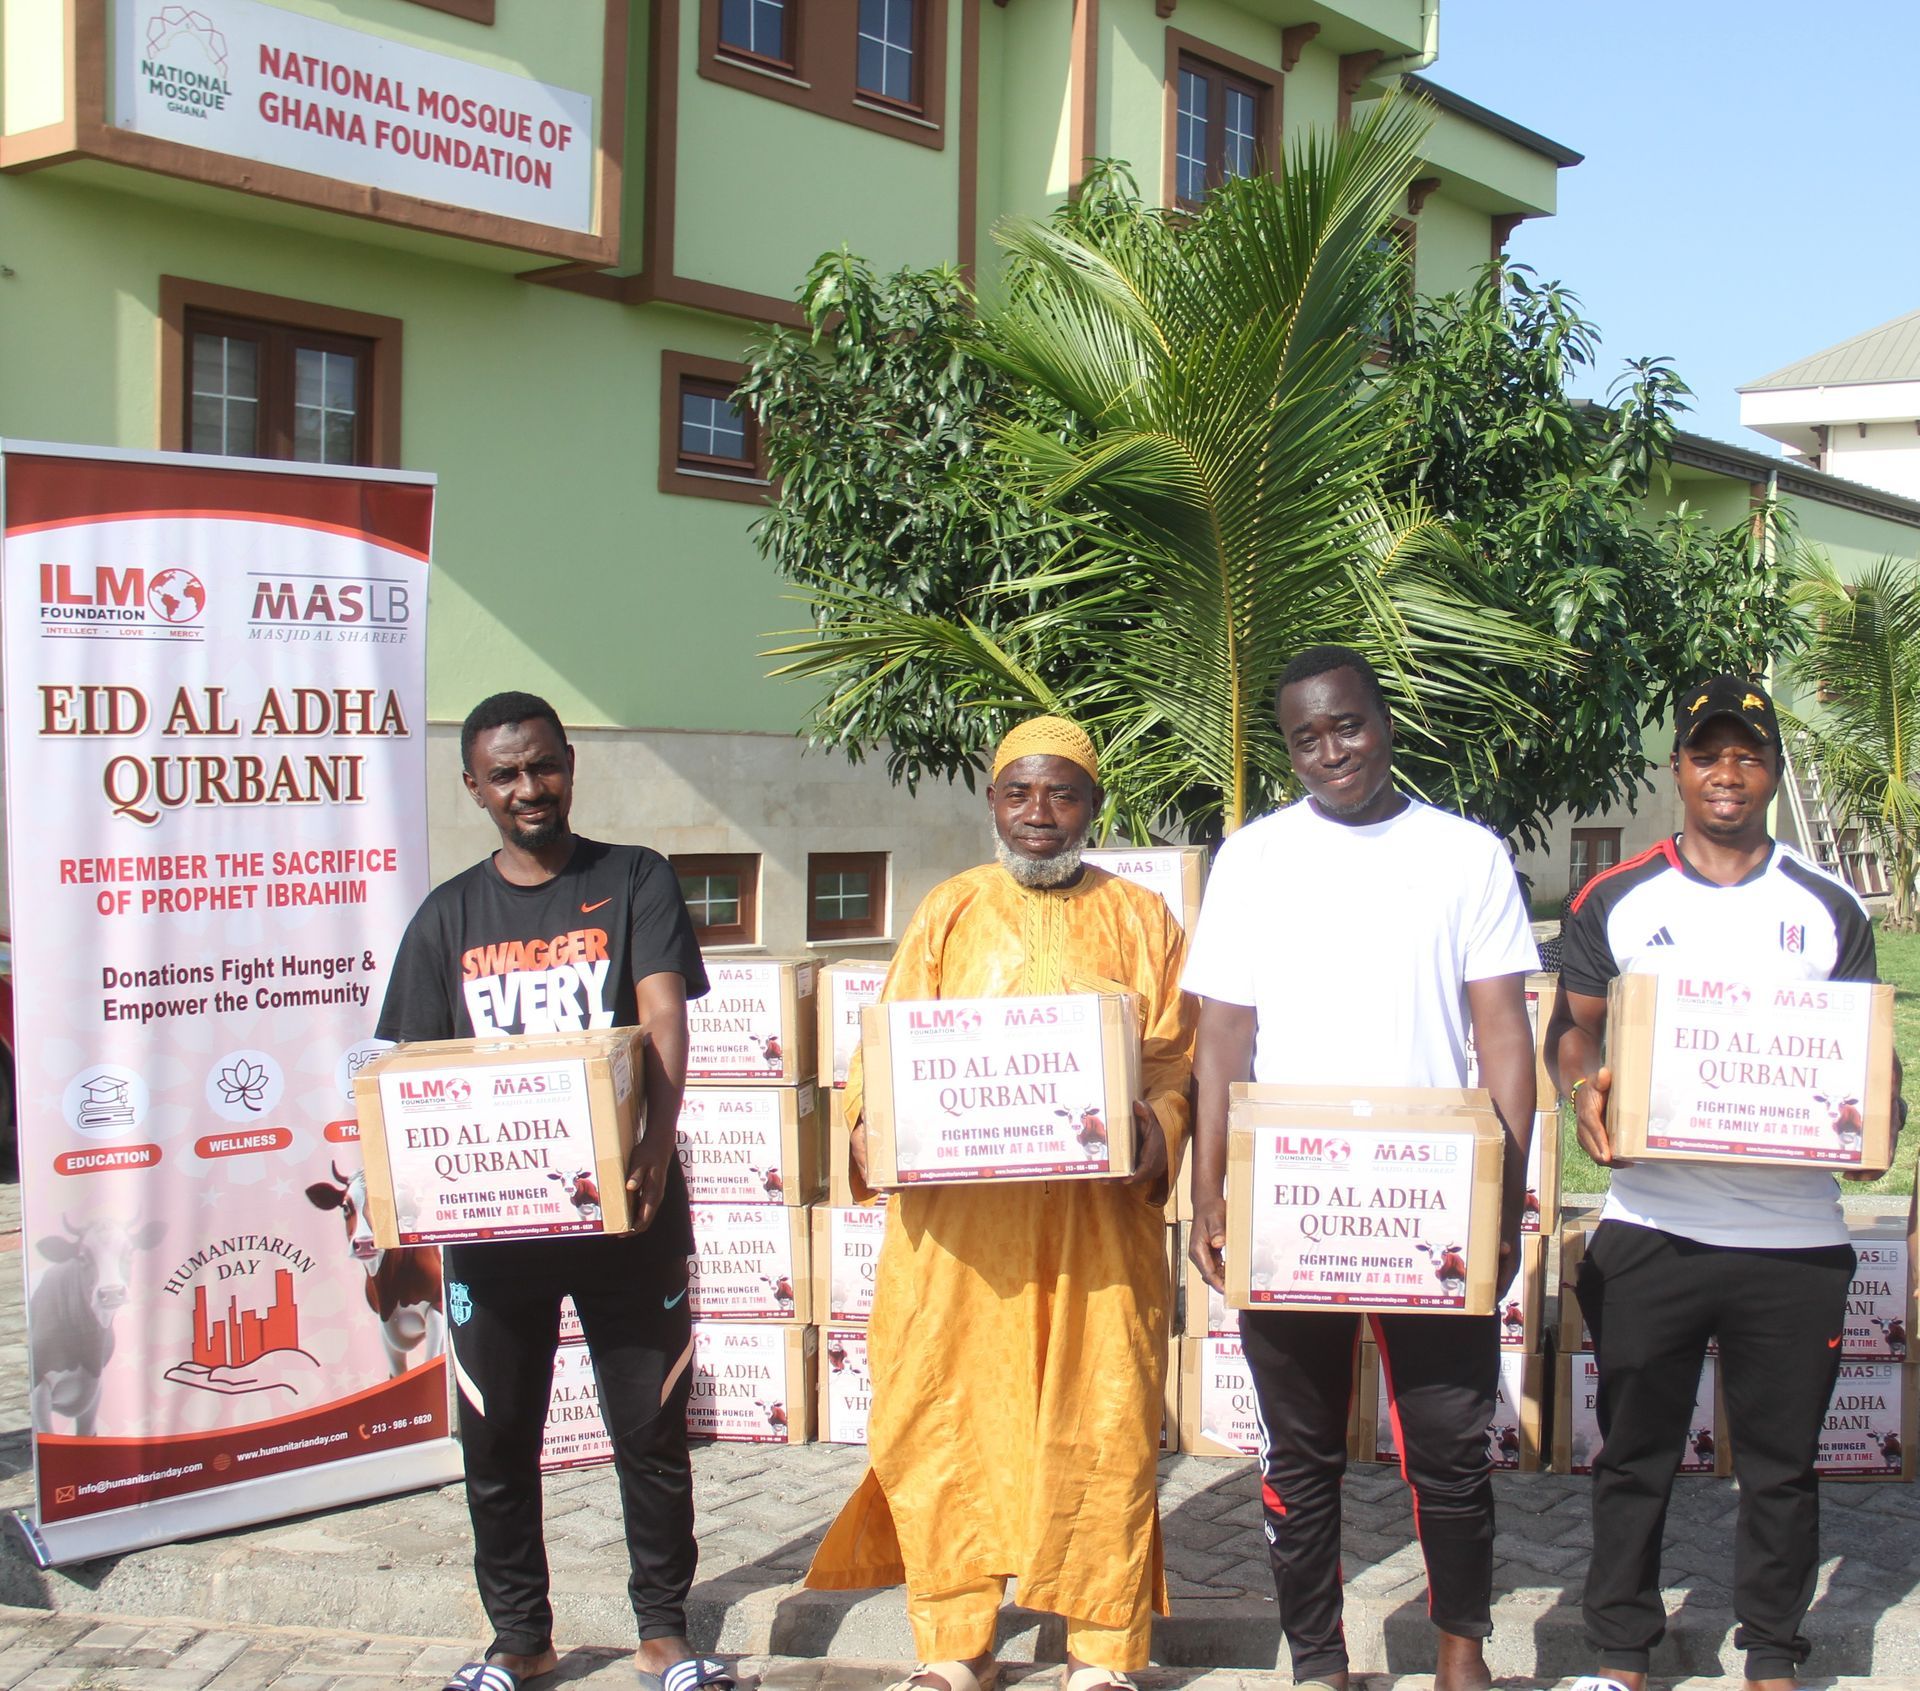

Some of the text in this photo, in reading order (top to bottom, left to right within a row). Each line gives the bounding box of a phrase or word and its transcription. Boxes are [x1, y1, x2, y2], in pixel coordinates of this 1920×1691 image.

[143, 60, 232, 95] NATIONAL
[150, 79, 224, 110] MOSQUE
[259, 44, 572, 152] NATIONAL MOSQUE OF
[167, 102, 208, 119] GHANA
[259, 91, 552, 190] GHANA FOUNDATION
[252, 582, 409, 623] MASLB
[41, 607, 144, 620] FOUNDATION
[248, 629, 408, 643] MASJID AL SHAREEF
[38, 685, 409, 736] EID AL ADHA
[103, 755, 364, 824] QURBANI
[60, 849, 397, 885] REMEMBER THE SACRIFICE
[97, 880, 367, 916] OF PROPHET IBRAHIM
[461, 928, 609, 981] SWAGGER
[103, 950, 375, 989] Donations Fight Hunger &
[103, 983, 369, 1024] Empower the Community
[463, 960, 611, 1029] EVERY
[692, 998, 766, 1013] AL ADHA
[690, 1018, 751, 1032] URBANI
[716, 1045, 749, 1053] HUNGER
[1674, 1027, 1844, 1060] EID AL ADHA
[738, 1055, 756, 1063] TIME
[912, 1052, 1080, 1080] EID AL ADHA
[1699, 1059, 1818, 1089] QURBANI
[939, 1083, 1058, 1117] QURBANI
[1697, 1101, 1810, 1119] FIGHTING HUNGER
[405, 1118, 570, 1148] EID AL ADHA
[942, 1125, 1054, 1141] FIGHTING HUNGER
[1690, 1117, 1820, 1136] ONE FAMILY AT A TIME
[210, 1134, 276, 1152] WELLNESS
[692, 1131, 766, 1145] AL ADHA
[678, 1150, 751, 1168] QURBANI
[937, 1141, 1065, 1158] ONE FAMILY AT A TIME
[67, 1151, 150, 1169] EDUCATION
[435, 1148, 550, 1182] QURBANI
[440, 1188, 548, 1204] FIGHTING HUNGER
[1274, 1184, 1447, 1210] EID AL ADHA
[436, 1203, 560, 1221] ONE FAMILY AT A TIME
[1300, 1214, 1421, 1243] QURBANI
[703, 1241, 776, 1255] AL ADHA
[844, 1243, 872, 1257] EID
[163, 1235, 316, 1295] HUMANITARIAN
[218, 1260, 261, 1280] DAY
[687, 1260, 761, 1279] QURBANI
[1299, 1254, 1413, 1268] FIGHTING HUNGER
[1293, 1270, 1423, 1284] ONE FAMILY AT A TIME
[728, 1286, 759, 1294] HUNGER
[699, 1364, 771, 1379] AL ADHA
[1215, 1375, 1244, 1389] EID
[552, 1387, 575, 1402] AL
[1835, 1396, 1886, 1410] ADHA
[372, 1414, 432, 1434] 213 986 6820
[1228, 1432, 1242, 1440] ONE
[237, 1431, 348, 1462] www.humanitarianday.com
[552, 1445, 579, 1455] FAMILY
[78, 1462, 203, 1495] info@humanitarianday.com
